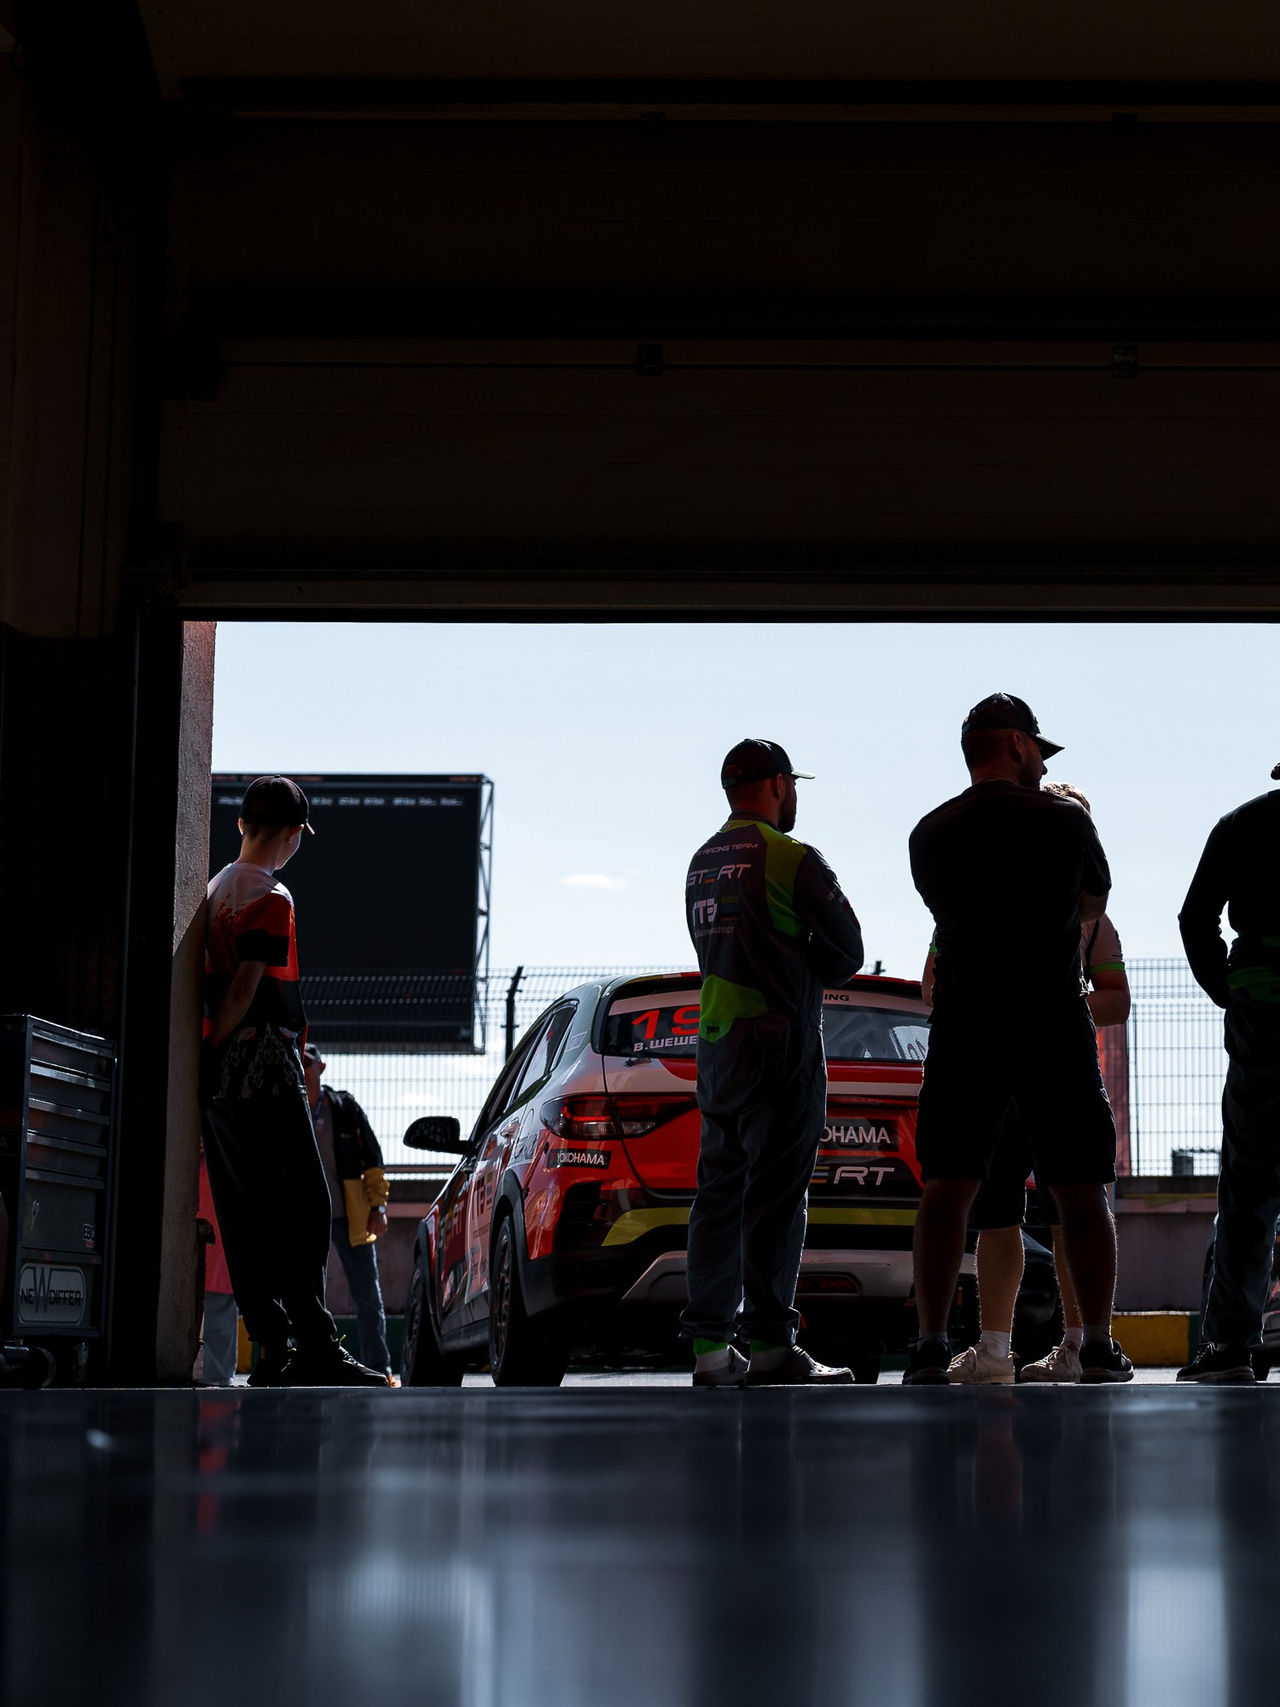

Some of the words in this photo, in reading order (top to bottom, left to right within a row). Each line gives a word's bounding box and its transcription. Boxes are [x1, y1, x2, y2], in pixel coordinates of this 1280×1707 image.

[731, 842, 759, 851] TEAM
[825, 993, 850, 1001] ING
[631, 1004, 701, 1040] 19
[633, 1035, 698, 1052] В.ШЕШЕ
[819, 1125, 892, 1144] OHAMA
[556, 1151, 605, 1165] YOKOHAMA
[48, 1289, 81, 1306] DIFFER
